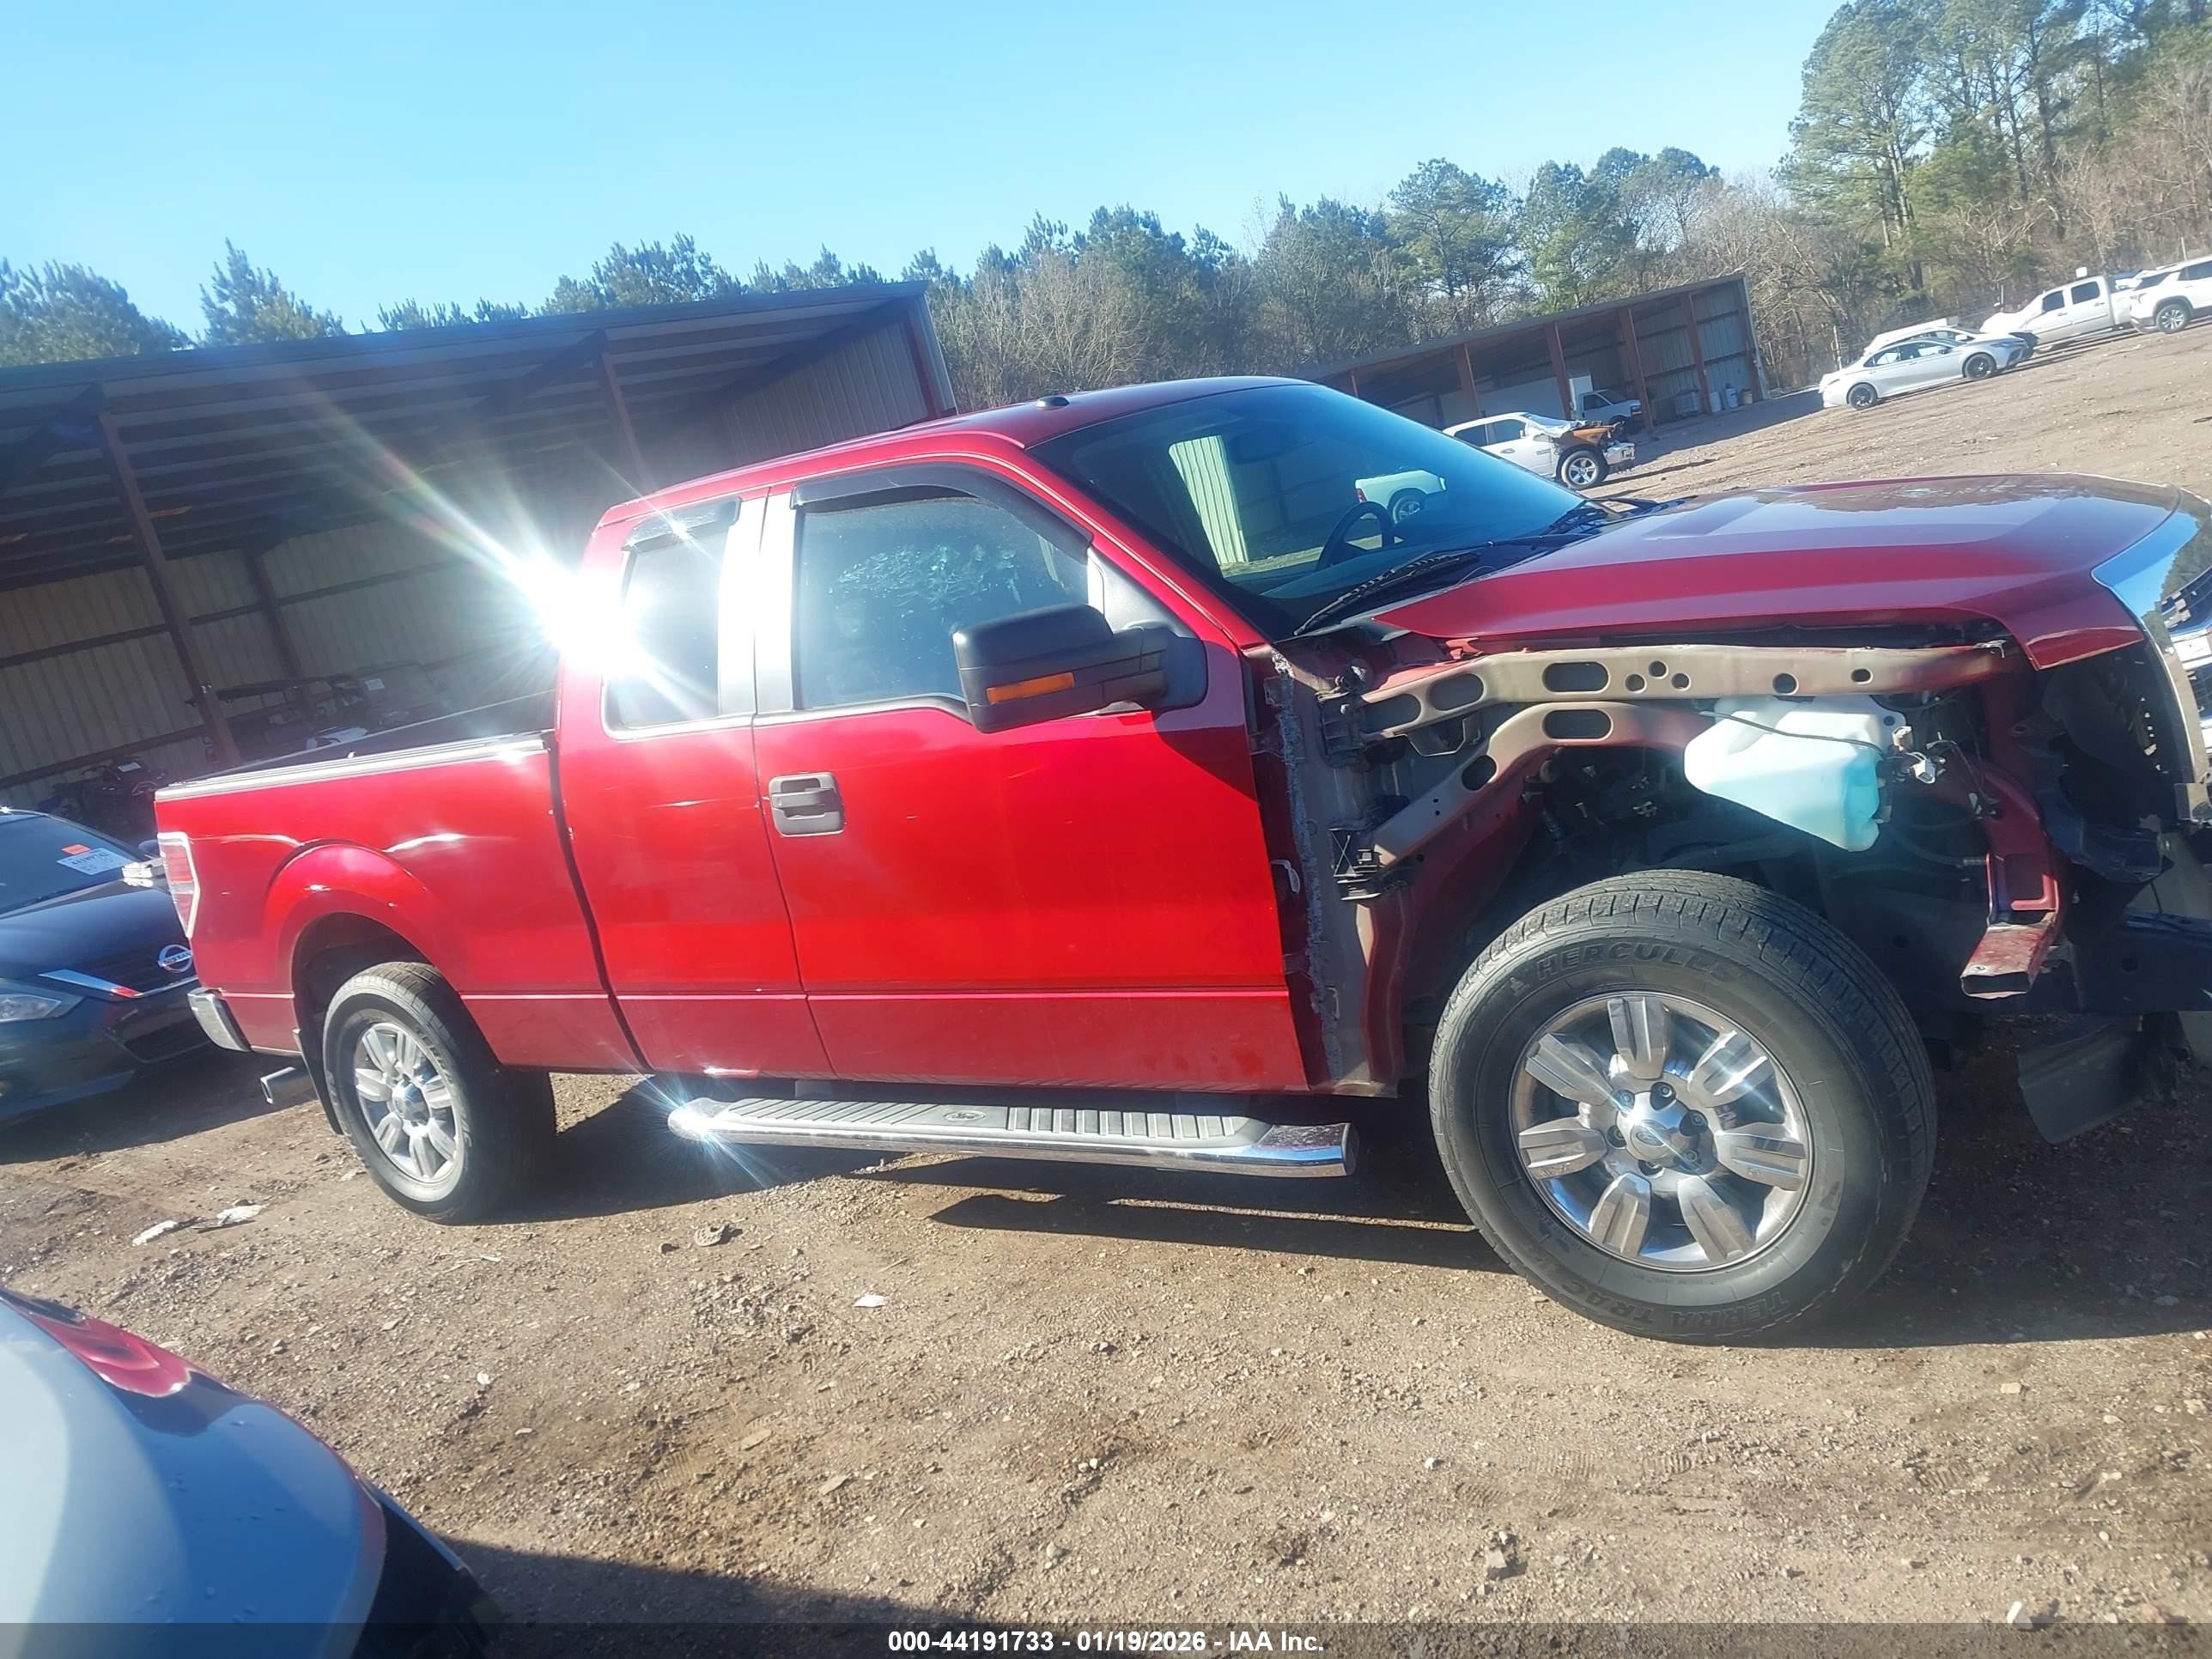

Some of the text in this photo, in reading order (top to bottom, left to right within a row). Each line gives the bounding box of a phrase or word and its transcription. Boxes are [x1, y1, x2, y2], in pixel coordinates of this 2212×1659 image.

[1536, 940, 1740, 984] HERCULES
[1559, 1277, 1790, 1332] TERRA TRAC
